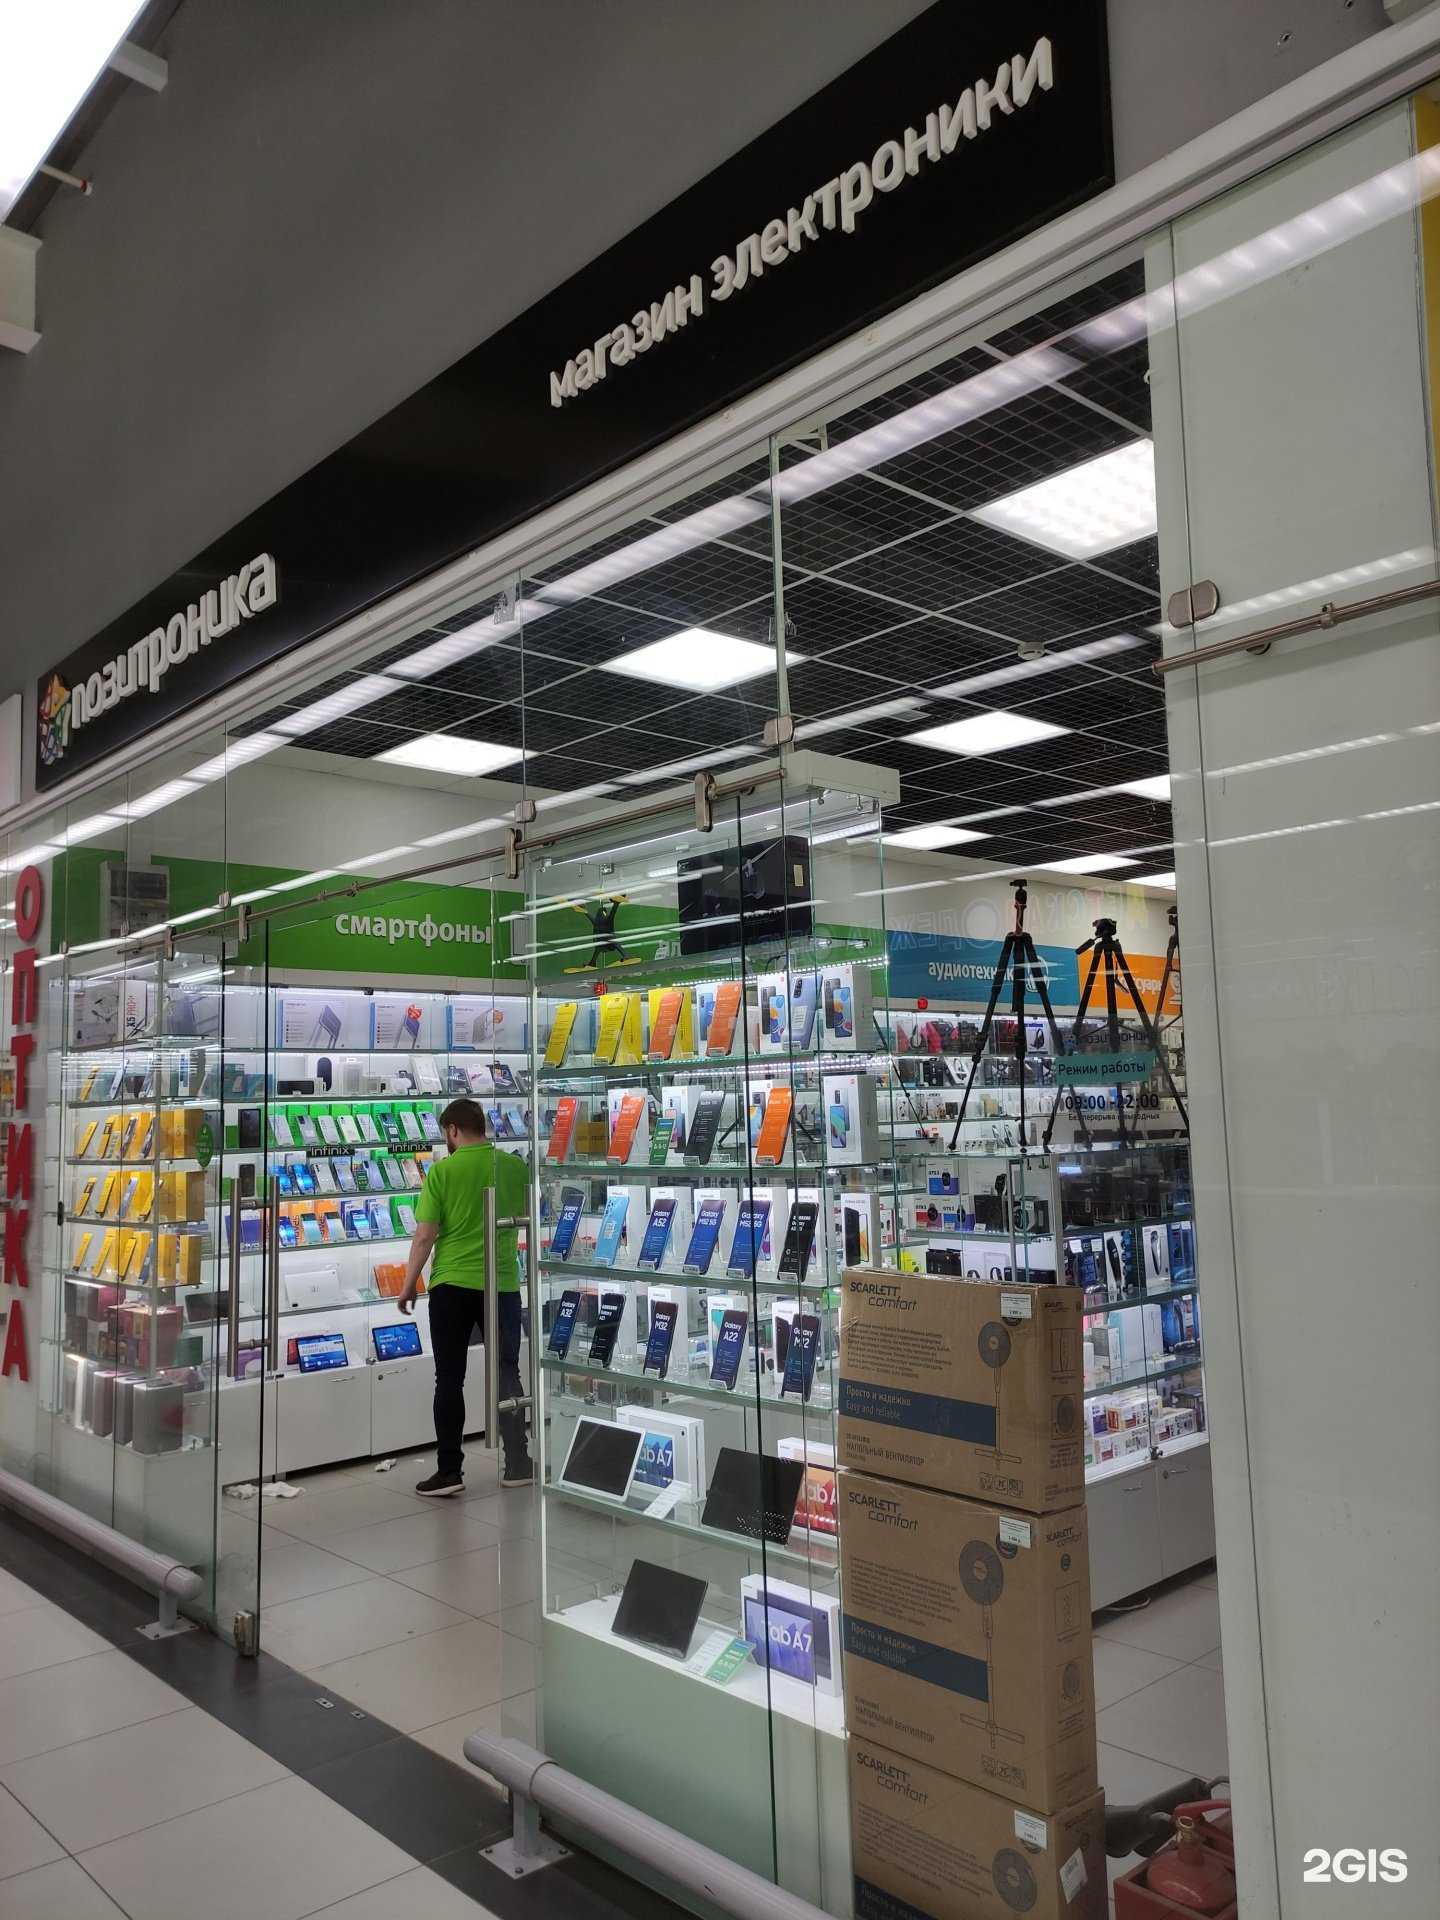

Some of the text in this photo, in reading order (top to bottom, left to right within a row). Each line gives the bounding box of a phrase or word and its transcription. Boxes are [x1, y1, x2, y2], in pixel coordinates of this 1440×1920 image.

[549, 36, 1054, 408] магазин электроники
[71, 551, 279, 729] позитроника
[336, 913, 492, 947] смартфоны
[1058, 1060, 1146, 1077] Режим работы
[1065, 1095, 1106, 1110] 09:00
[1, 864, 43, 1383] ОПТИКА
[653, 1210, 671, 1218] Galaxy
[701, 1210, 720, 1219] Galaxy
[652, 1218, 666, 1227] A52
[850, 1281, 901, 1297] SCARLETT
[868, 1295, 918, 1311] comfort
[560, 1308, 573, 1318] A32
[655, 1312, 671, 1321] Galaxy
[655, 1321, 668, 1331] M32
[724, 1321, 742, 1331] Galaxy
[723, 1331, 739, 1342] A22
[848, 1491, 901, 1513] SCARLETT
[868, 1510, 919, 1529] comfort
[792, 1632, 813, 1653] A7
[857, 1752, 912, 1782] SCARLETT
[877, 1775, 928, 1805] comfort
